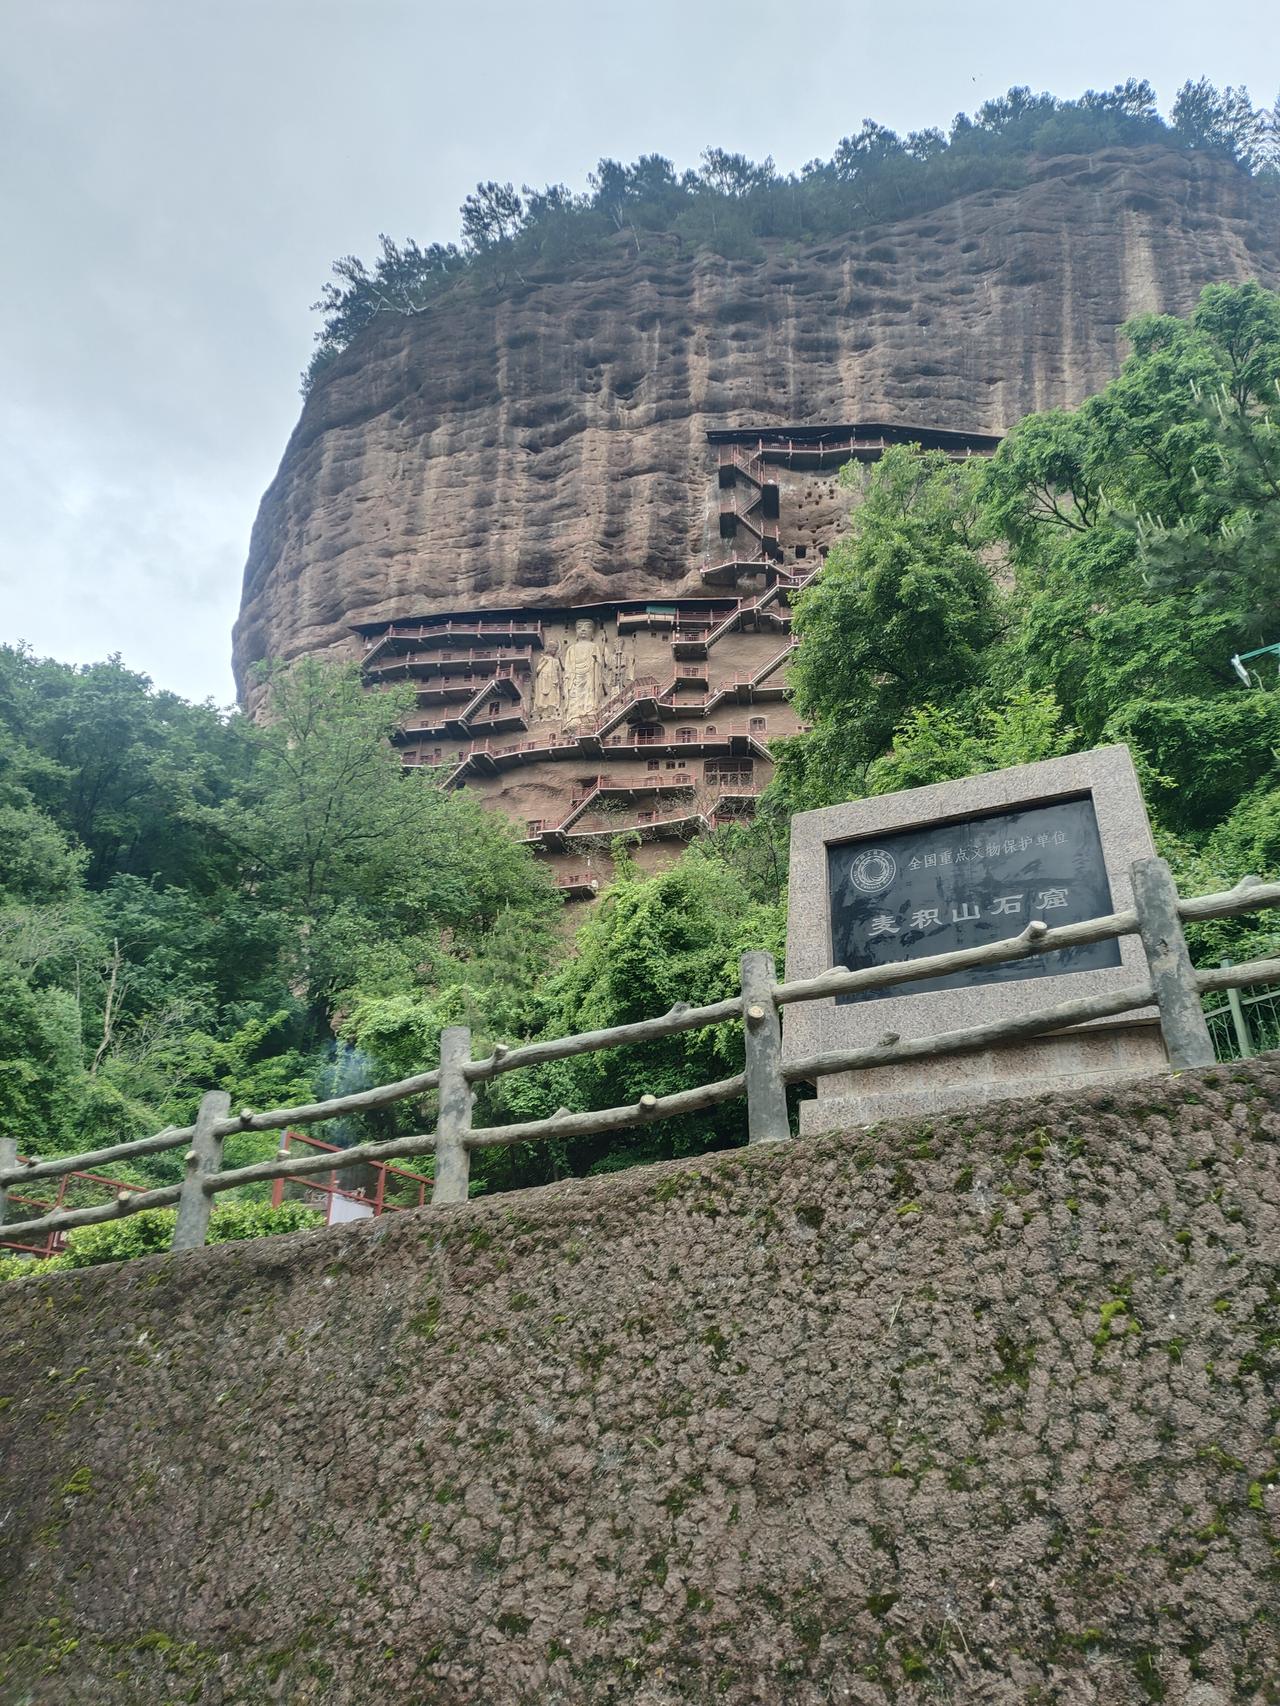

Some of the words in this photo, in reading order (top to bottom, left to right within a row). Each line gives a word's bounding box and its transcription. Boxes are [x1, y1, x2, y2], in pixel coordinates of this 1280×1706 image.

[908, 831, 1068, 871] 全国重点文物保护单位
[869, 888, 1069, 936] 麦积山石窟
